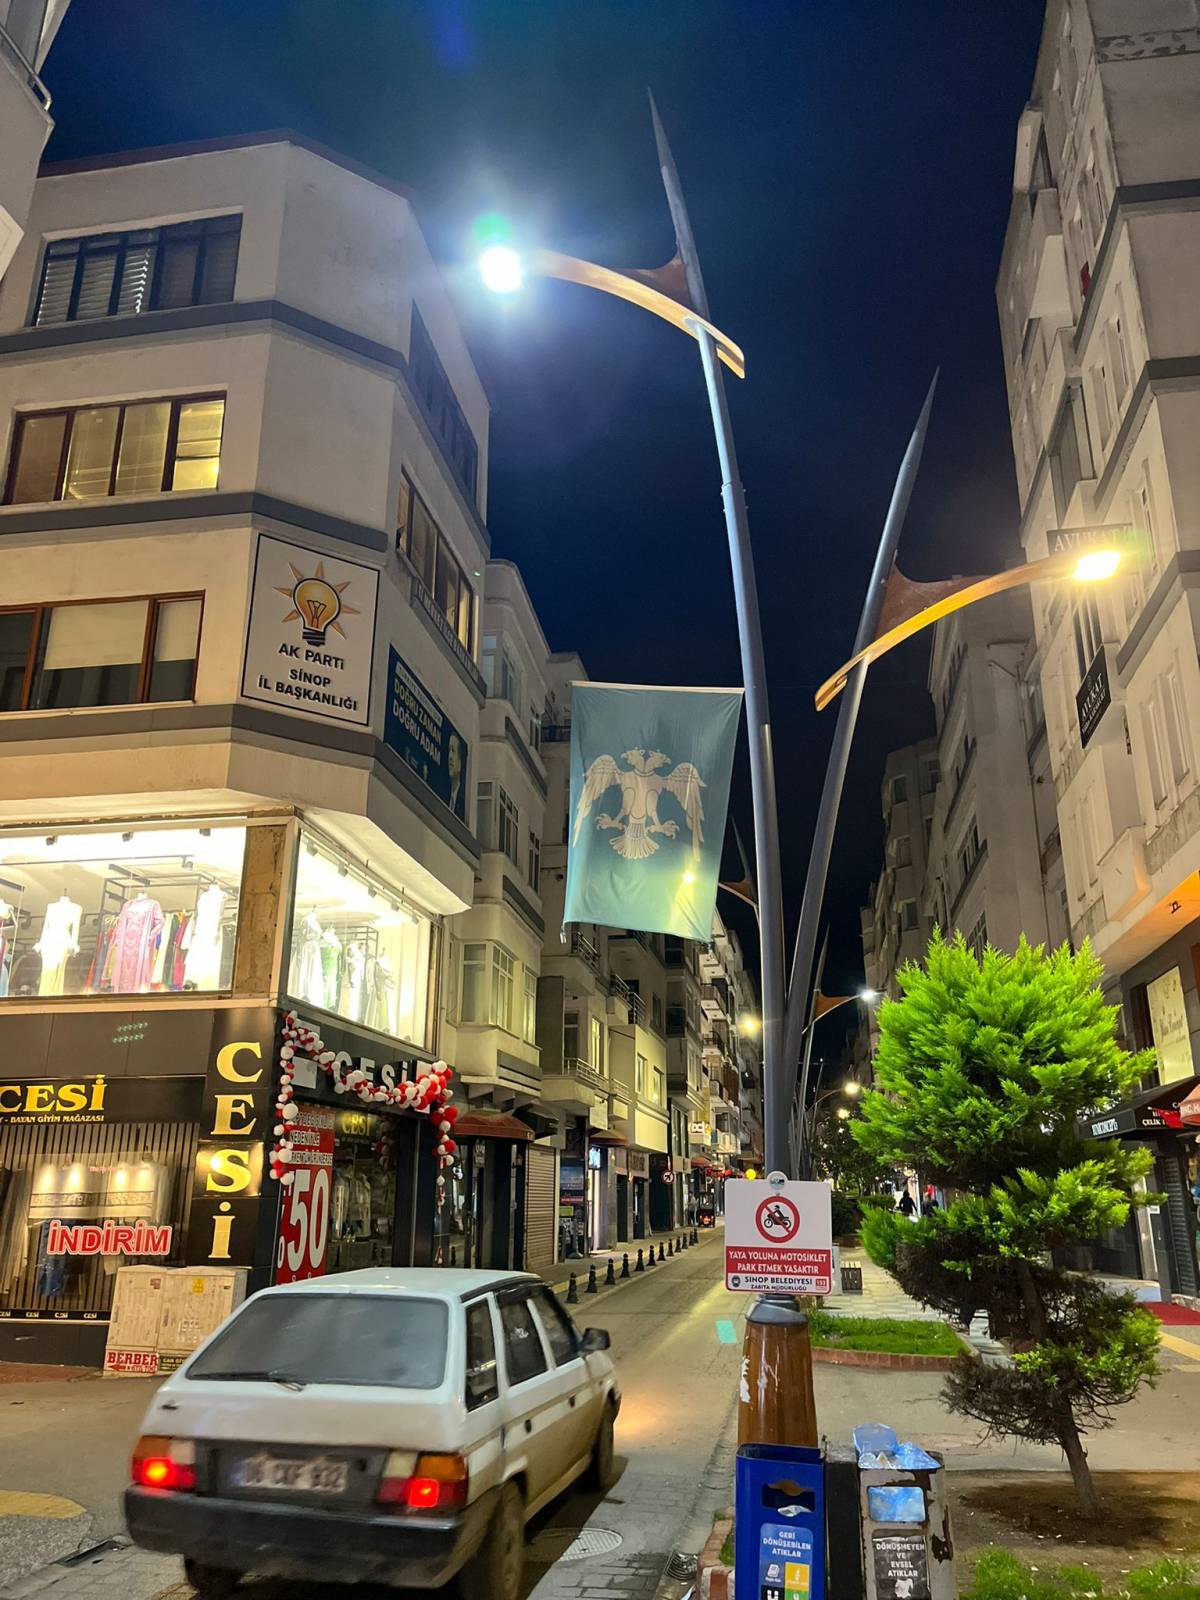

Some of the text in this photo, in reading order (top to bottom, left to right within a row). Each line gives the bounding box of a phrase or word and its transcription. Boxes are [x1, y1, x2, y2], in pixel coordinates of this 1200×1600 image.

[278, 643, 344, 670] AK PARTİ
[289, 669, 331, 688] SİNOP
[258, 674, 357, 712] İL BAŞKANLIĞI
[394, 677, 419, 716] DOĞRU
[418, 707, 442, 746] ZAMAN
[392, 698, 420, 742] DOĞRU
[419, 734, 441, 767] ADAM
[0, 1074, 108, 1113] CESİ
[37, 1114, 61, 1123] GİYİM
[62, 1114, 105, 1122] MAĞAZASI
[1142, 1118, 1162, 1127] ÇELİK
[47, 1219, 173, 1256] İNDİRİM
[729, 1250, 747, 1259] YAYA
[748, 1251, 778, 1261] YOLUNA
[737, 1263, 819, 1275] PARK ETMEK YASAKTIR
[107, 1352, 158, 1366] BERBER
[779, 1531, 796, 1539] GERİ
[762, 1538, 811, 1551] DÖNÜŞEBİLEN
[876, 1541, 925, 1551] DÖNÜŞMEYEN
[771, 1549, 802, 1558] ATIKLAR
[890, 1560, 914, 1568] EVSEL
[887, 1569, 919, 1577] ATIKLAR
